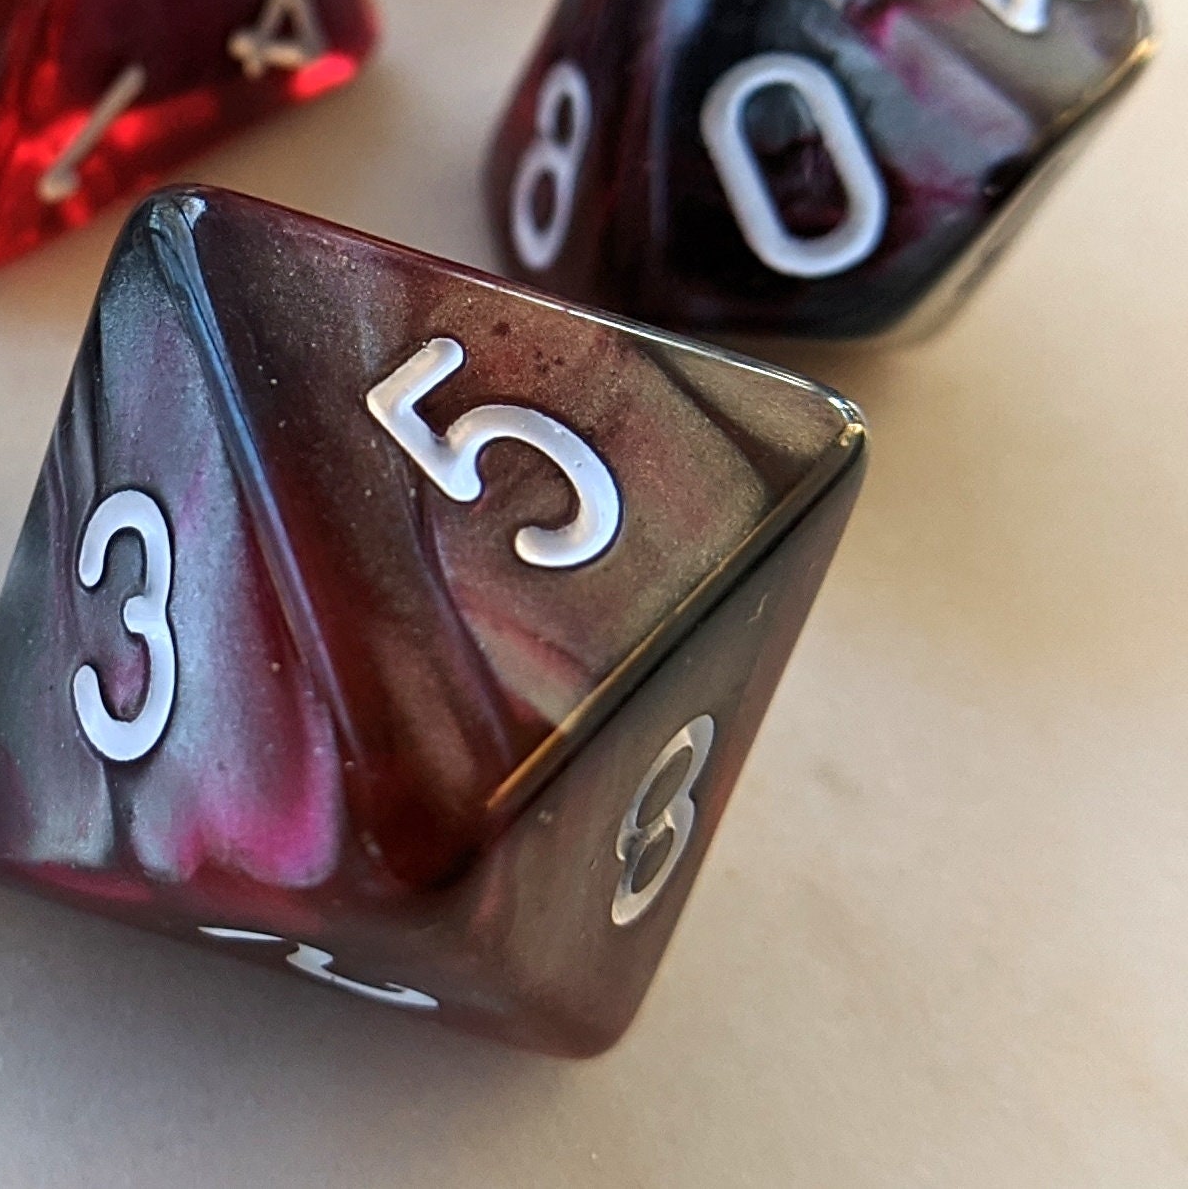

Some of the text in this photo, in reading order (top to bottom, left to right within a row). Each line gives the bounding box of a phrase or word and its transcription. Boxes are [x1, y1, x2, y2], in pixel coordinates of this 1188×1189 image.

[512, 59, 592, 271] 8
[699, 50, 888, 280] 0
[366, 336, 622, 569] 5
[72, 488, 175, 763] 3
